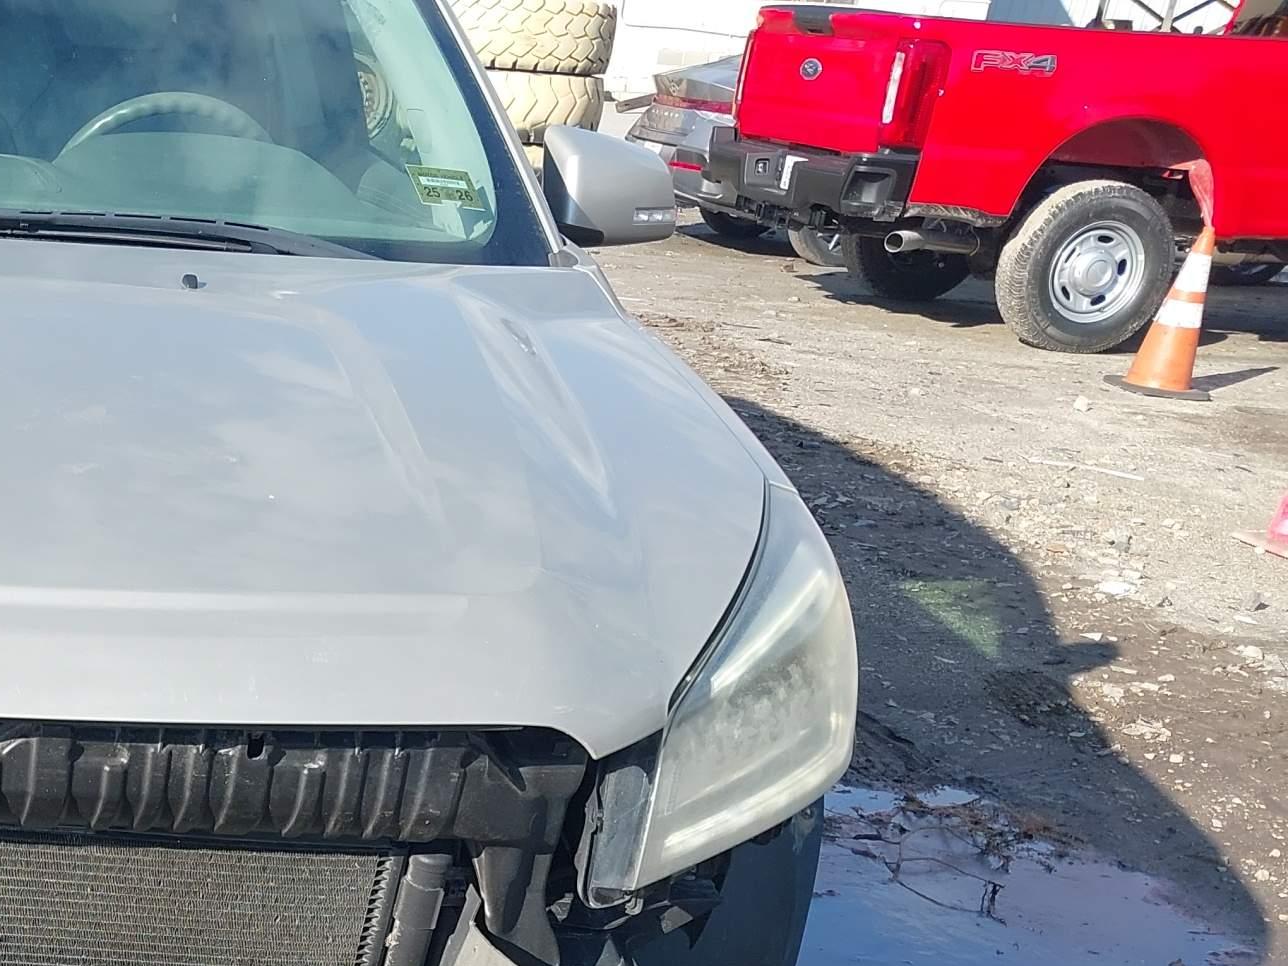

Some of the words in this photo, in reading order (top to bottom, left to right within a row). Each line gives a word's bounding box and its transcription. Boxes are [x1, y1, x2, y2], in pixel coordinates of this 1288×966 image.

[971, 49, 1057, 77] FX4
[424, 187, 441, 198] 25
[455, 189, 473, 201] 26
